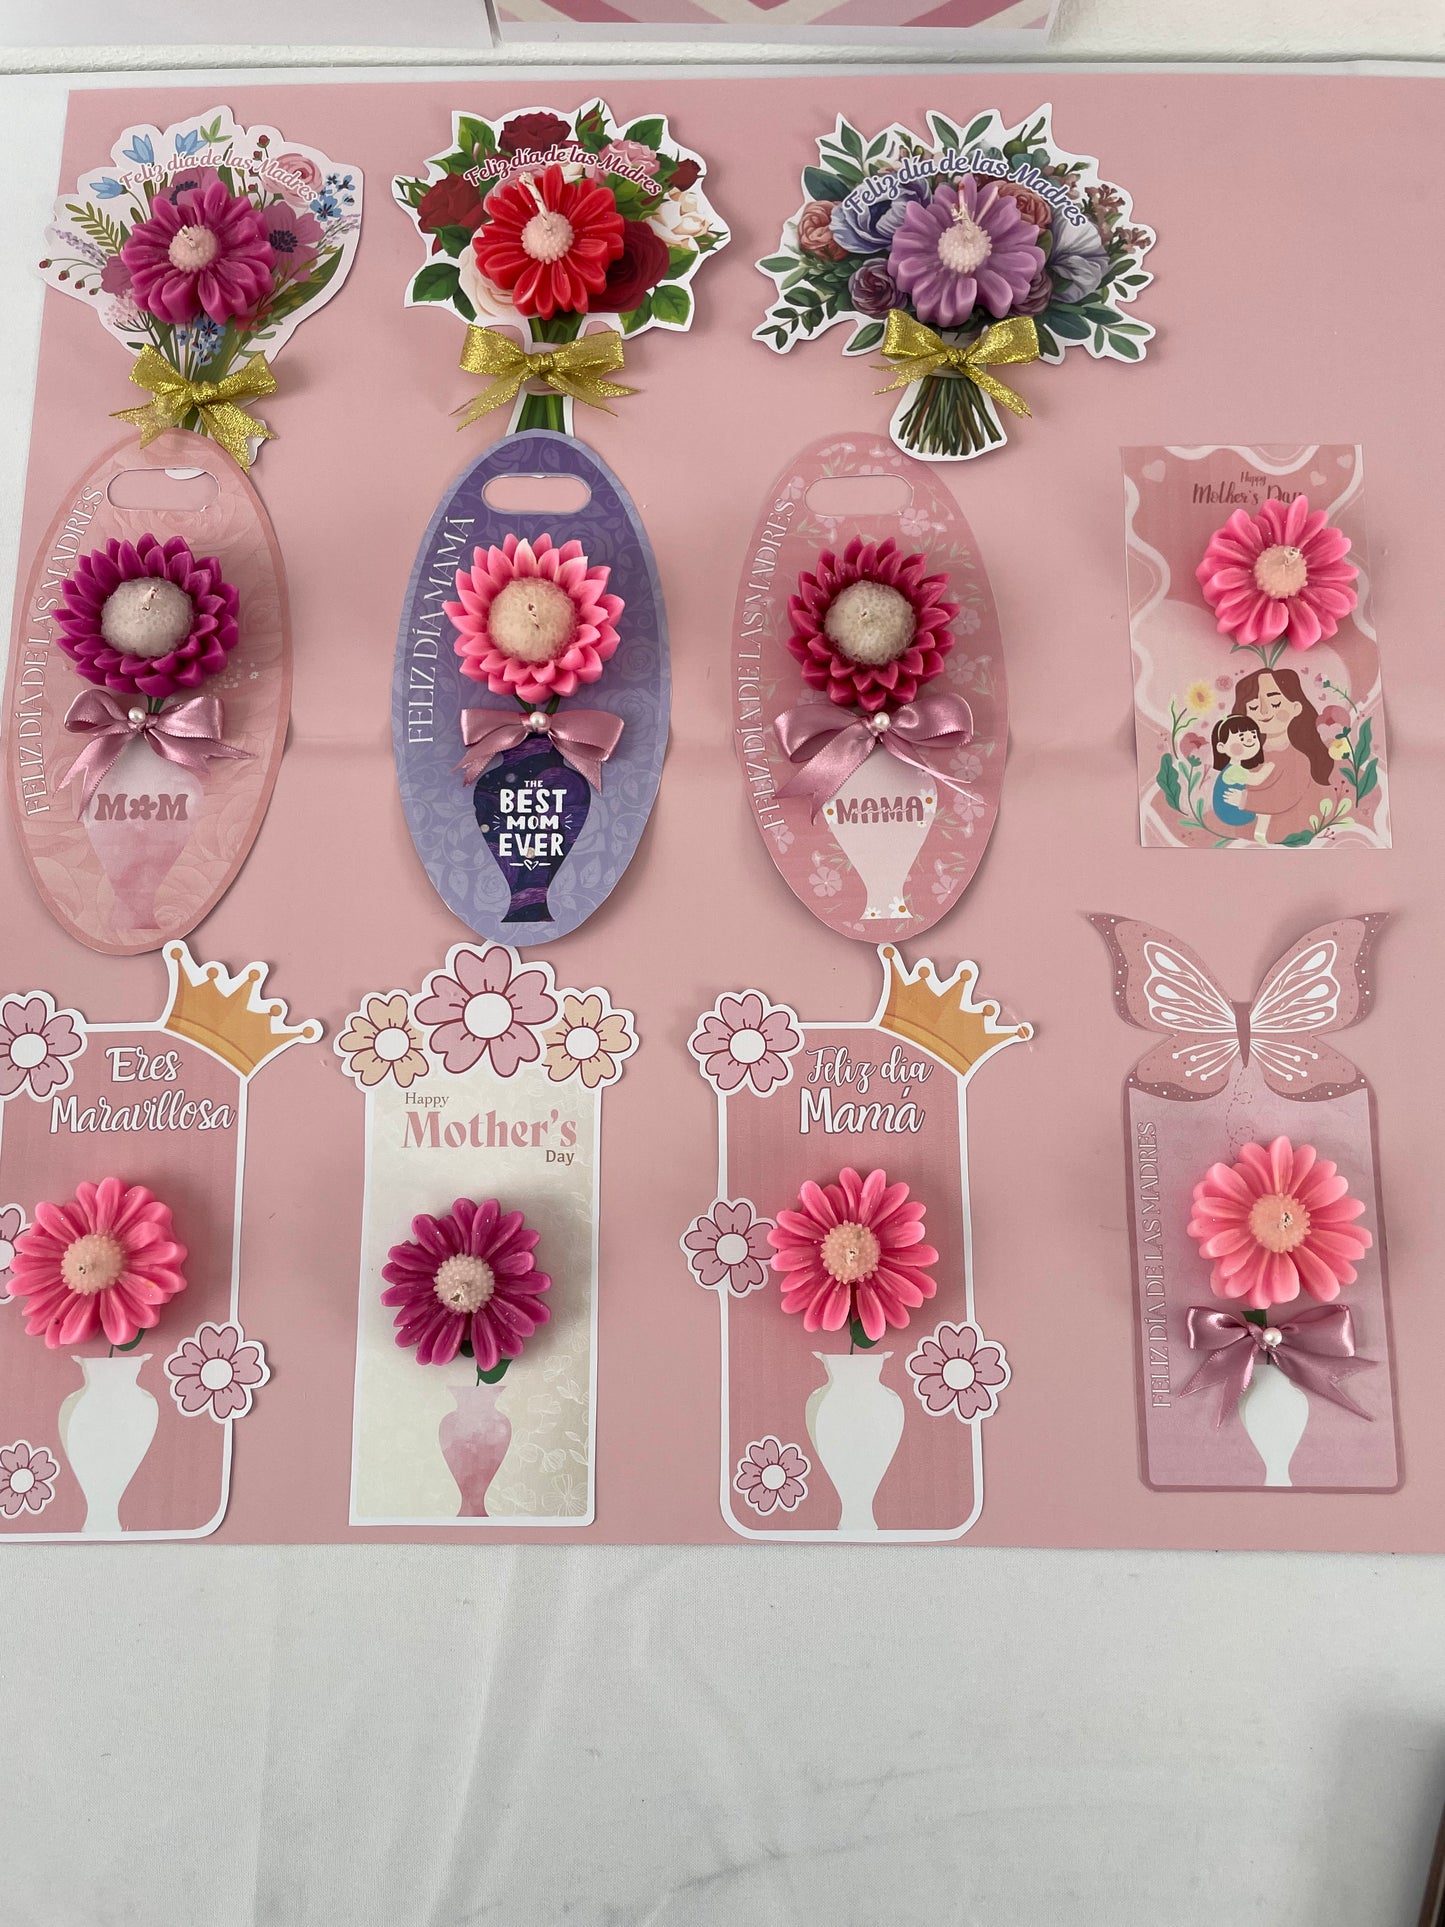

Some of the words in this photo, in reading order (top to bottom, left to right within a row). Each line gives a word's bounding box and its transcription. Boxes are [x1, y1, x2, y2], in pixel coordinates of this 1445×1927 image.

[119, 162, 166, 189] Feliz
[167, 150, 197, 171] día
[199, 148, 222, 166] de
[222, 149, 252, 170] las
[255, 161, 317, 202] Madres
[465, 157, 512, 185] Feliz
[511, 146, 543, 170] día
[543, 145, 566, 164] de
[568, 145, 597, 166] las
[599, 157, 662, 196] Madres
[843, 172, 901, 215] Feliz
[899, 155, 936, 185] día
[938, 152, 969, 174] de
[971, 149, 1008, 177] las
[1010, 164, 1087, 227] Madres
[1192, 481, 1259, 505] Mother's
[1240, 471, 1267, 487] Happy
[41, 486, 104, 593] MADRES
[424, 516, 475, 603] MAMÁ
[745, 498, 796, 606] MADRES
[28, 596, 58, 644] LAS
[412, 611, 445, 659] DÍA
[738, 611, 765, 659] LAS
[22, 651, 48, 686] DE
[737, 666, 761, 701] DE
[15, 692, 43, 738] DÍA
[408, 666, 436, 743] FELIZ
[736, 707, 766, 753] DÍA
[20, 743, 50, 816] FELIZ
[500, 789, 567, 813] BEST
[524, 780, 544, 788] THE
[746, 758, 785, 829] FELIZ
[506, 815, 559, 830] MOM
[836, 796, 924, 825] MAMA
[499, 833, 564, 857] EVER
[104, 1045, 183, 1082] Eres
[805, 1045, 878, 1095] Feliz
[879, 1045, 934, 1084] día
[49, 1089, 236, 1135] Maravillosa
[405, 1092, 450, 1108] Happy
[800, 1086, 926, 1135] Mamá
[401, 1108, 577, 1149] Mother's
[545, 1150, 575, 1166] Day
[1137, 1122, 1161, 1215] MADRES
[1143, 1219, 1163, 1260] LAS
[1145, 1265, 1165, 1296] DE
[1144, 1302, 1167, 1341] DÍA
[1150, 1347, 1171, 1408] FELIZ
